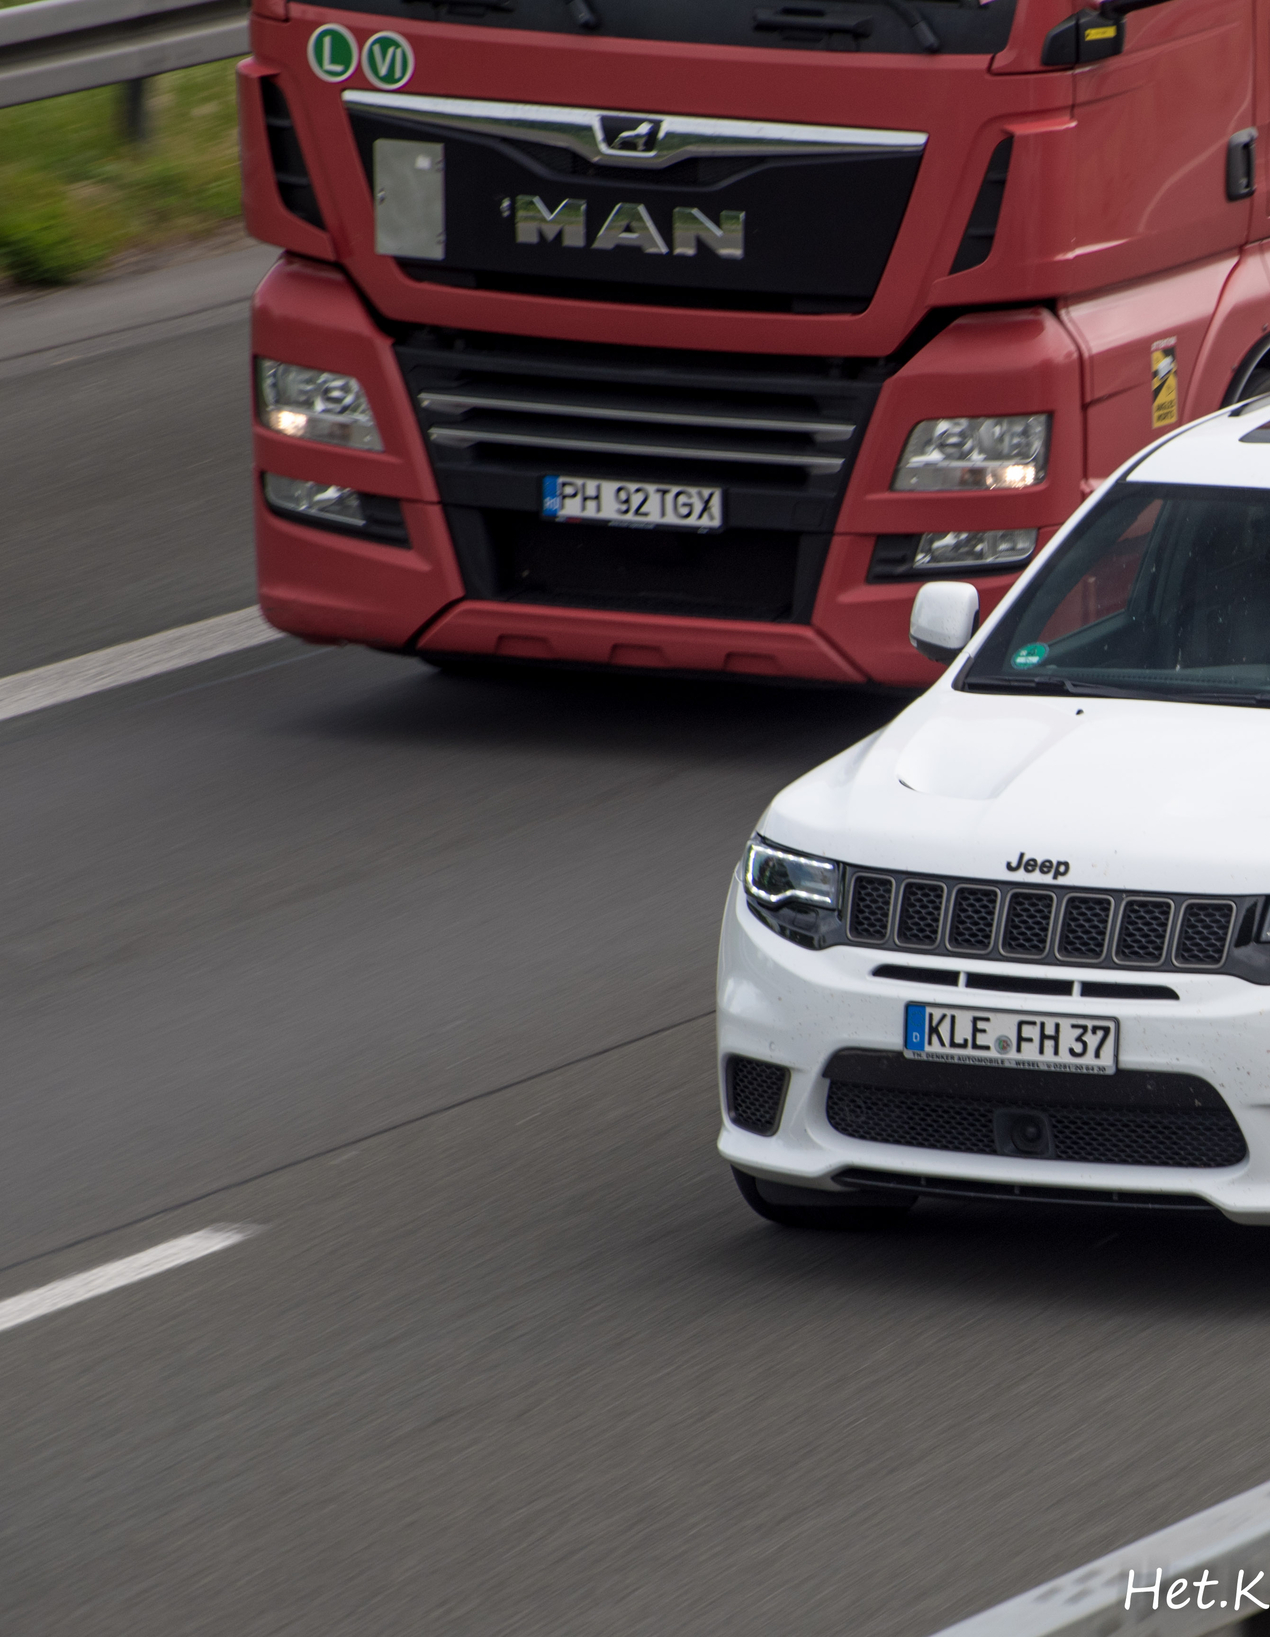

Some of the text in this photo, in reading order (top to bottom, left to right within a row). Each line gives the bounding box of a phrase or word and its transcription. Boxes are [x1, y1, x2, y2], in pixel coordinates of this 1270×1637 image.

[322, 35, 345, 73] L
[372, 43, 403, 79] VI
[515, 194, 746, 260] MAN
[560, 481, 602, 514] PH
[1006, 852, 1070, 880] Jeep
[912, 1031, 920, 1042] D
[927, 1012, 1111, 1059] KLE FH 37
[926, 1053, 955, 1062] DENKER
[957, 1055, 1005, 1066] AUTOMOBILE
[1015, 1060, 1040, 1068] WESEL
